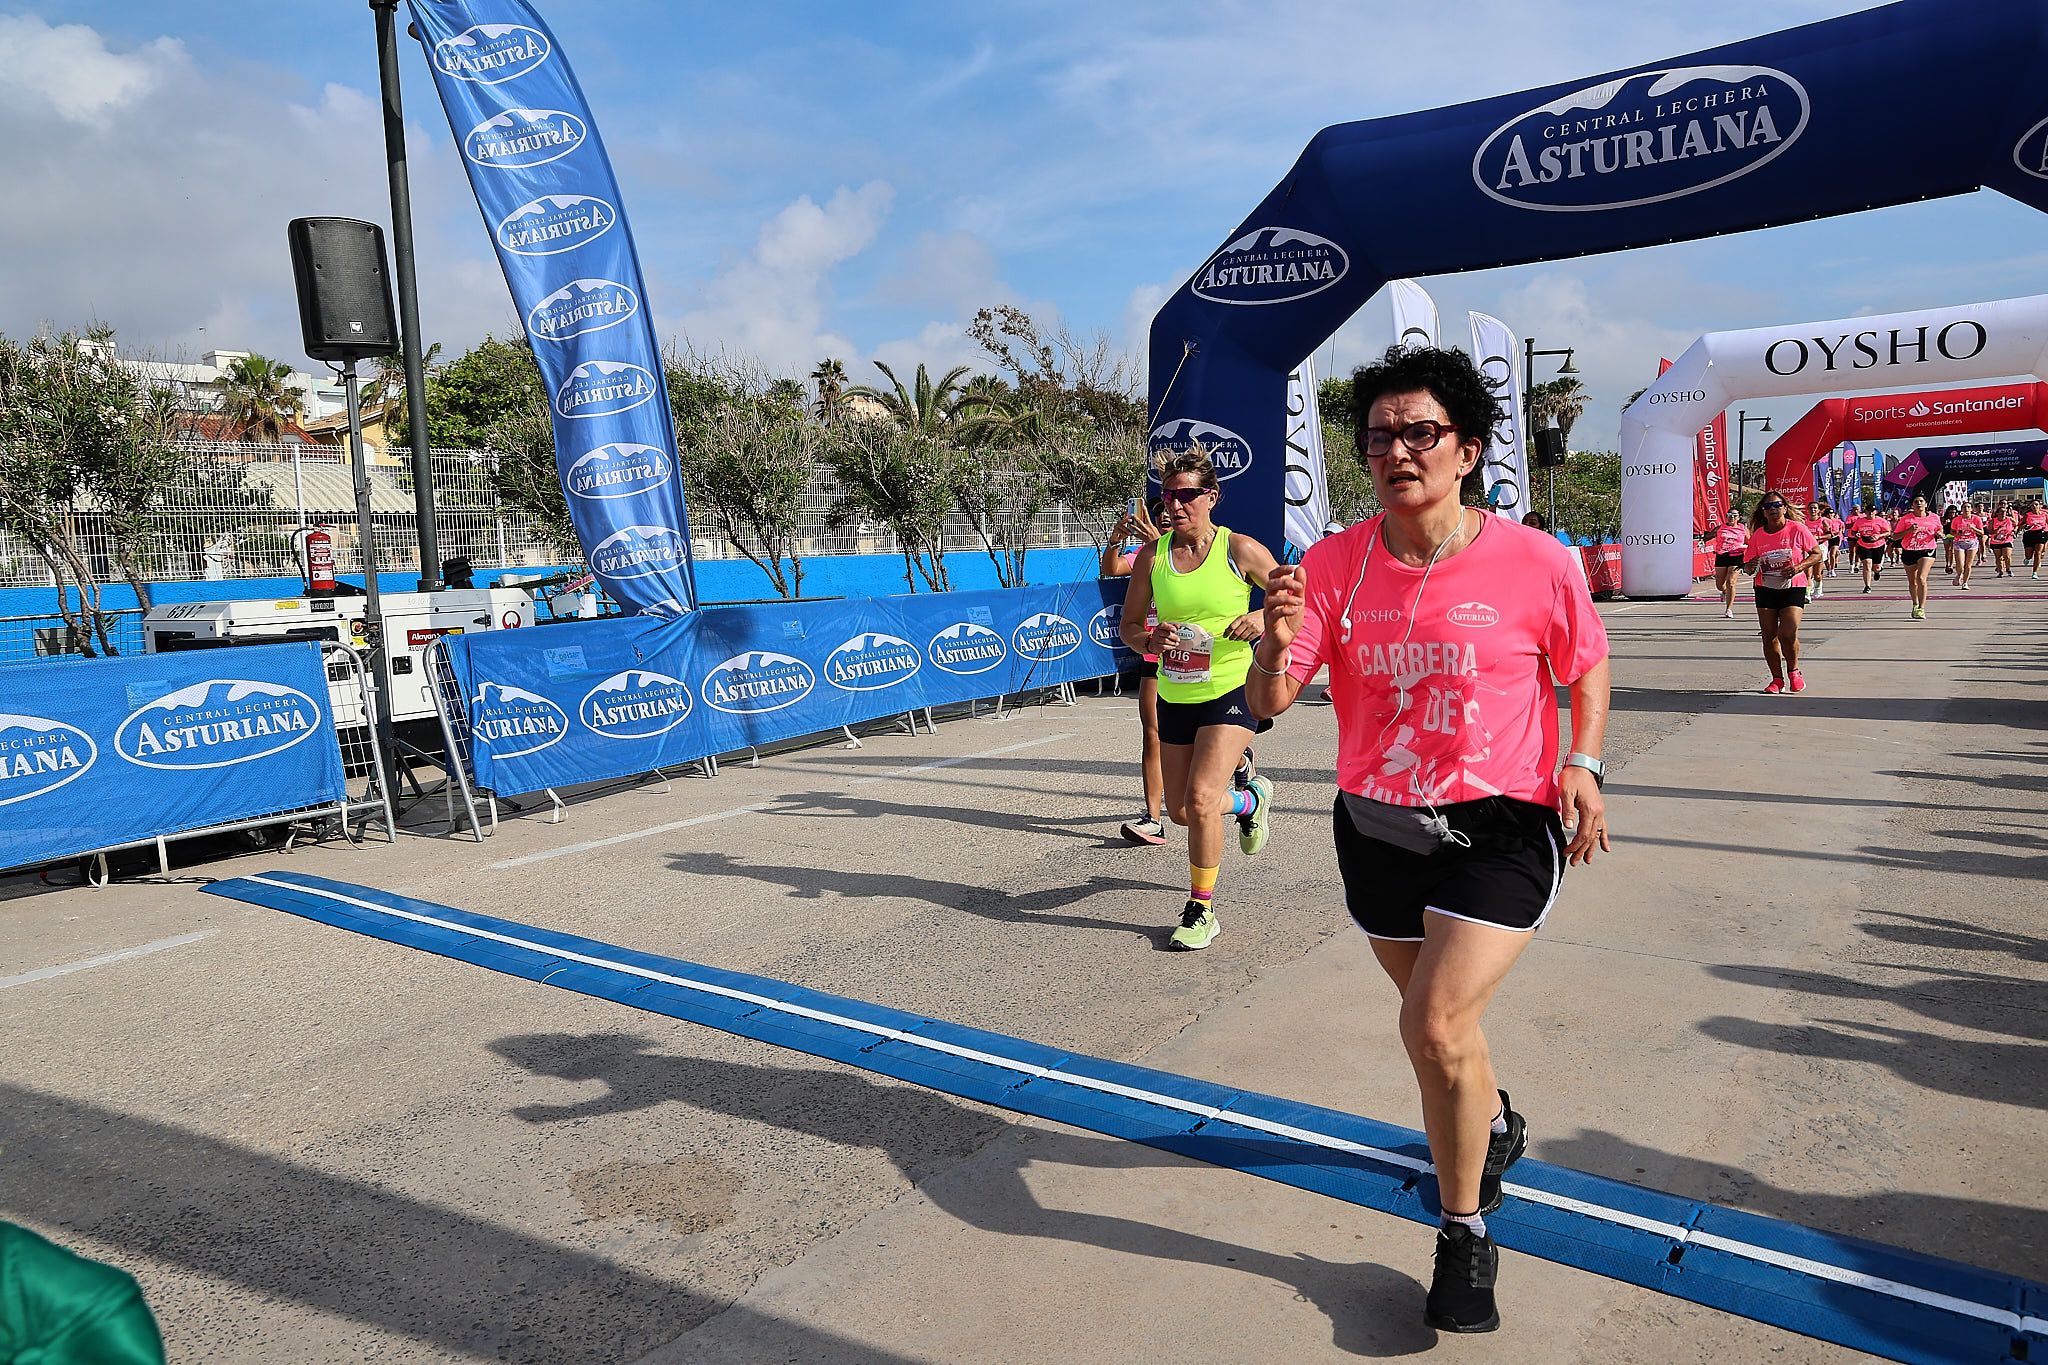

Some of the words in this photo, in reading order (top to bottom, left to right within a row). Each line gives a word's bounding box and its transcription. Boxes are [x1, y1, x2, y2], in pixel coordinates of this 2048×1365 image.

[1544, 108, 1644, 139] CENTRAL
[1656, 83, 1769, 118] LECHERA
[1497, 104, 1782, 190] ASTURIANA
[1222, 252, 1269, 266] CENTRAL
[1274, 249, 1329, 260] LECHERA
[1197, 259, 1336, 290] ASTURIANA
[1765, 320, 1988, 376] OYSHO
[1649, 389, 1706, 405] OYSHO
[1854, 406, 1906, 424] Sports
[1933, 395, 2025, 415] Santander
[1906, 418, 1962, 428] sportssantander.es
[1959, 448, 1990, 458] octopus
[1991, 447, 2017, 456] energy
[1626, 463, 1677, 477] OYSHO
[1625, 533, 1675, 546] OYSHO
[1353, 609, 1401, 623] OYSHO
[1452, 610, 1495, 623] ASTURIANA
[1019, 632, 1078, 653] ASTURIANA
[936, 643, 1003, 664] ASTURIANA
[1170, 650, 1190, 661] 016
[1358, 643, 1477, 677] CARRERA
[726, 671, 764, 683] CENTRAL
[765, 665, 802, 678] LECHERA
[834, 654, 916, 683] ASTURIANA
[604, 692, 643, 705] CENTRAL
[644, 686, 681, 699] LECHERA
[713, 673, 809, 705] ASTURIANA
[164, 709, 231, 726] CENTRAL
[236, 698, 298, 715] LECHERA
[592, 695, 687, 728] ASTURIANA
[135, 710, 309, 758] ASTURIANA
